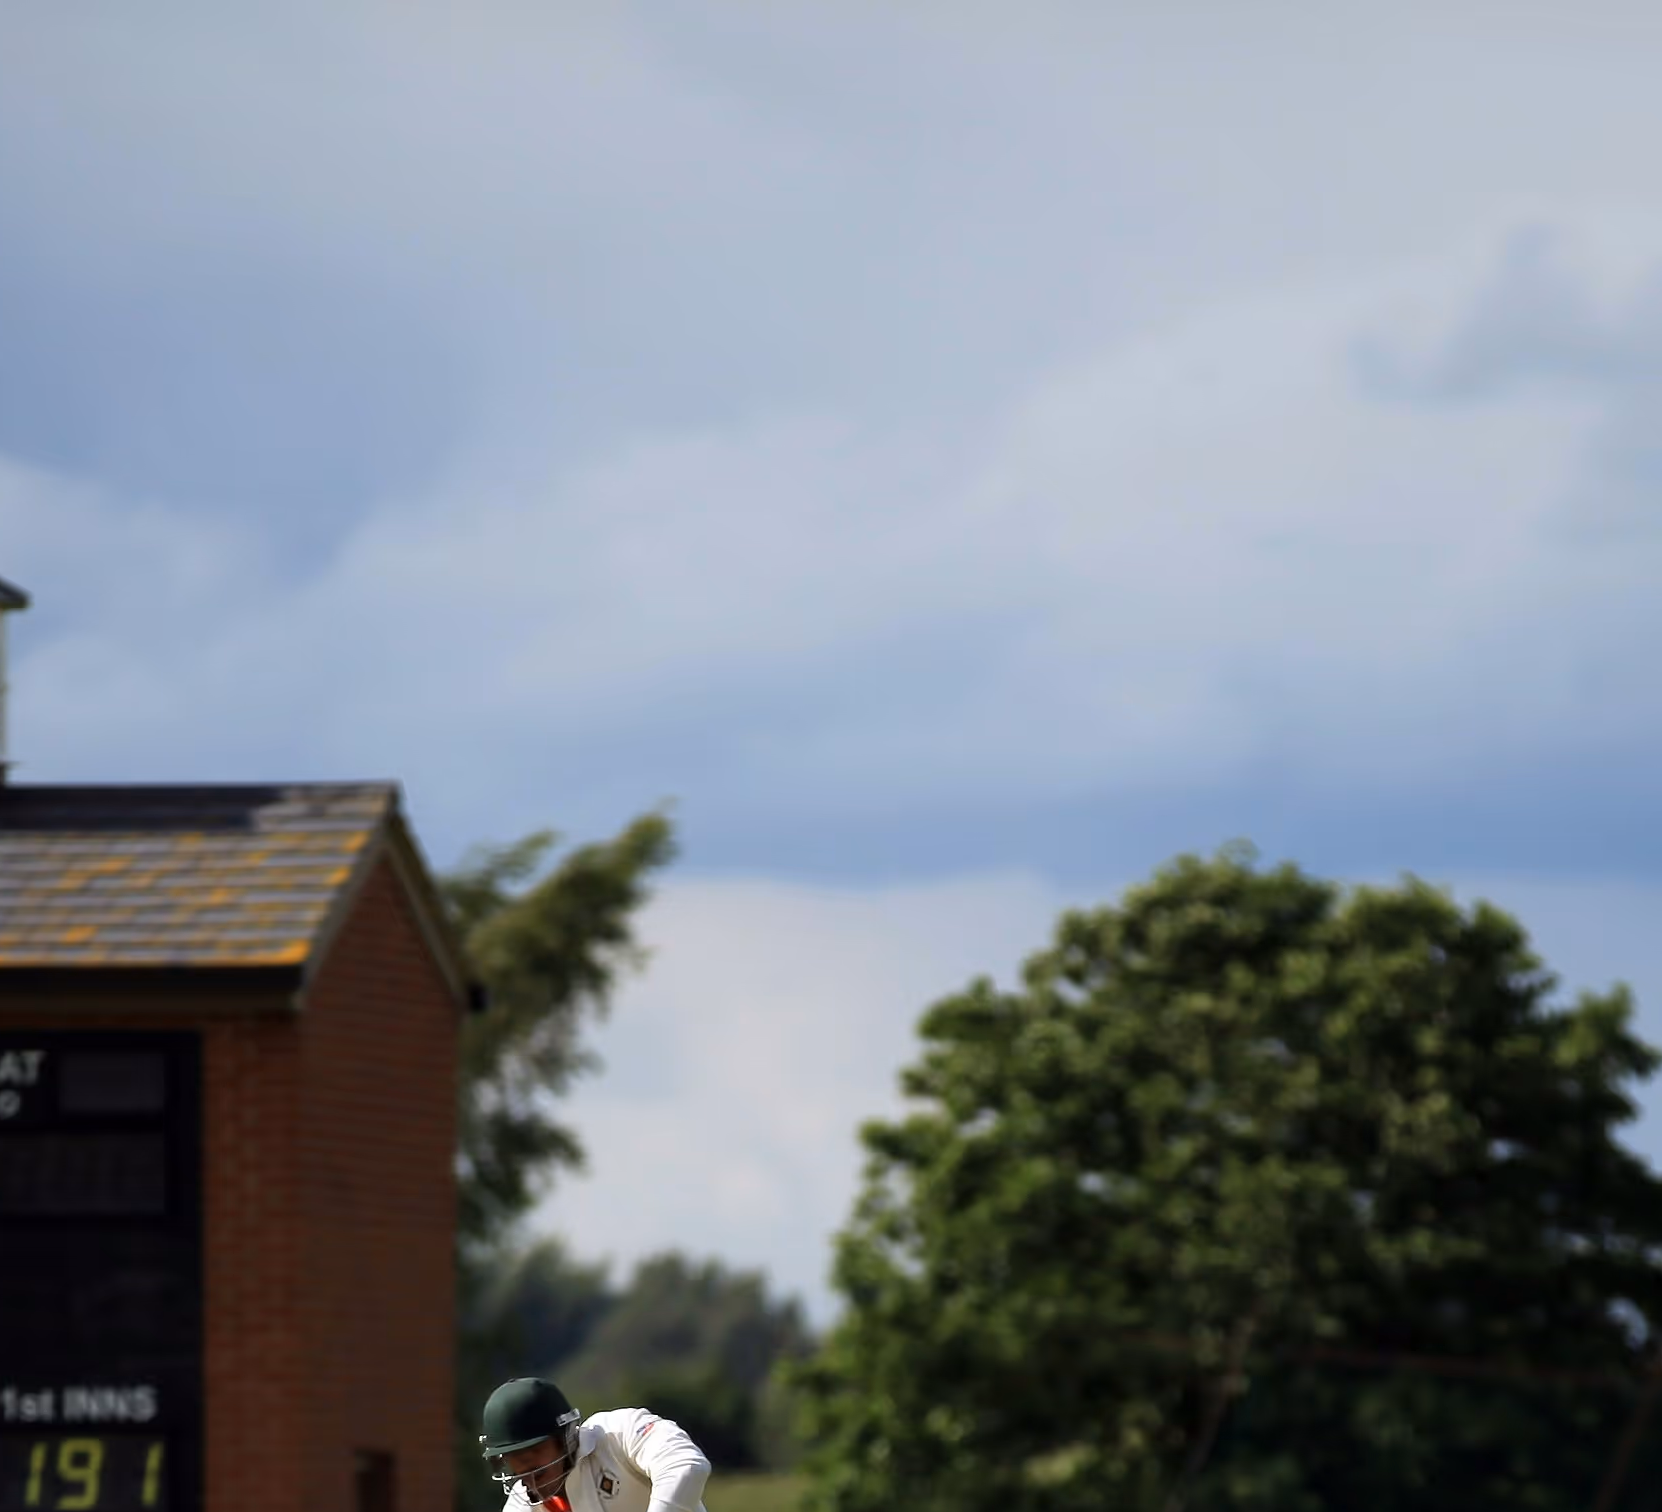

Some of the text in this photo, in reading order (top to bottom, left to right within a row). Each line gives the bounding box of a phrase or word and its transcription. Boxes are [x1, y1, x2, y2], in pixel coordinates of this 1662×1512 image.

[0, 1387, 157, 1421] 1st INNS
[25, 1438, 162, 1511] 191
